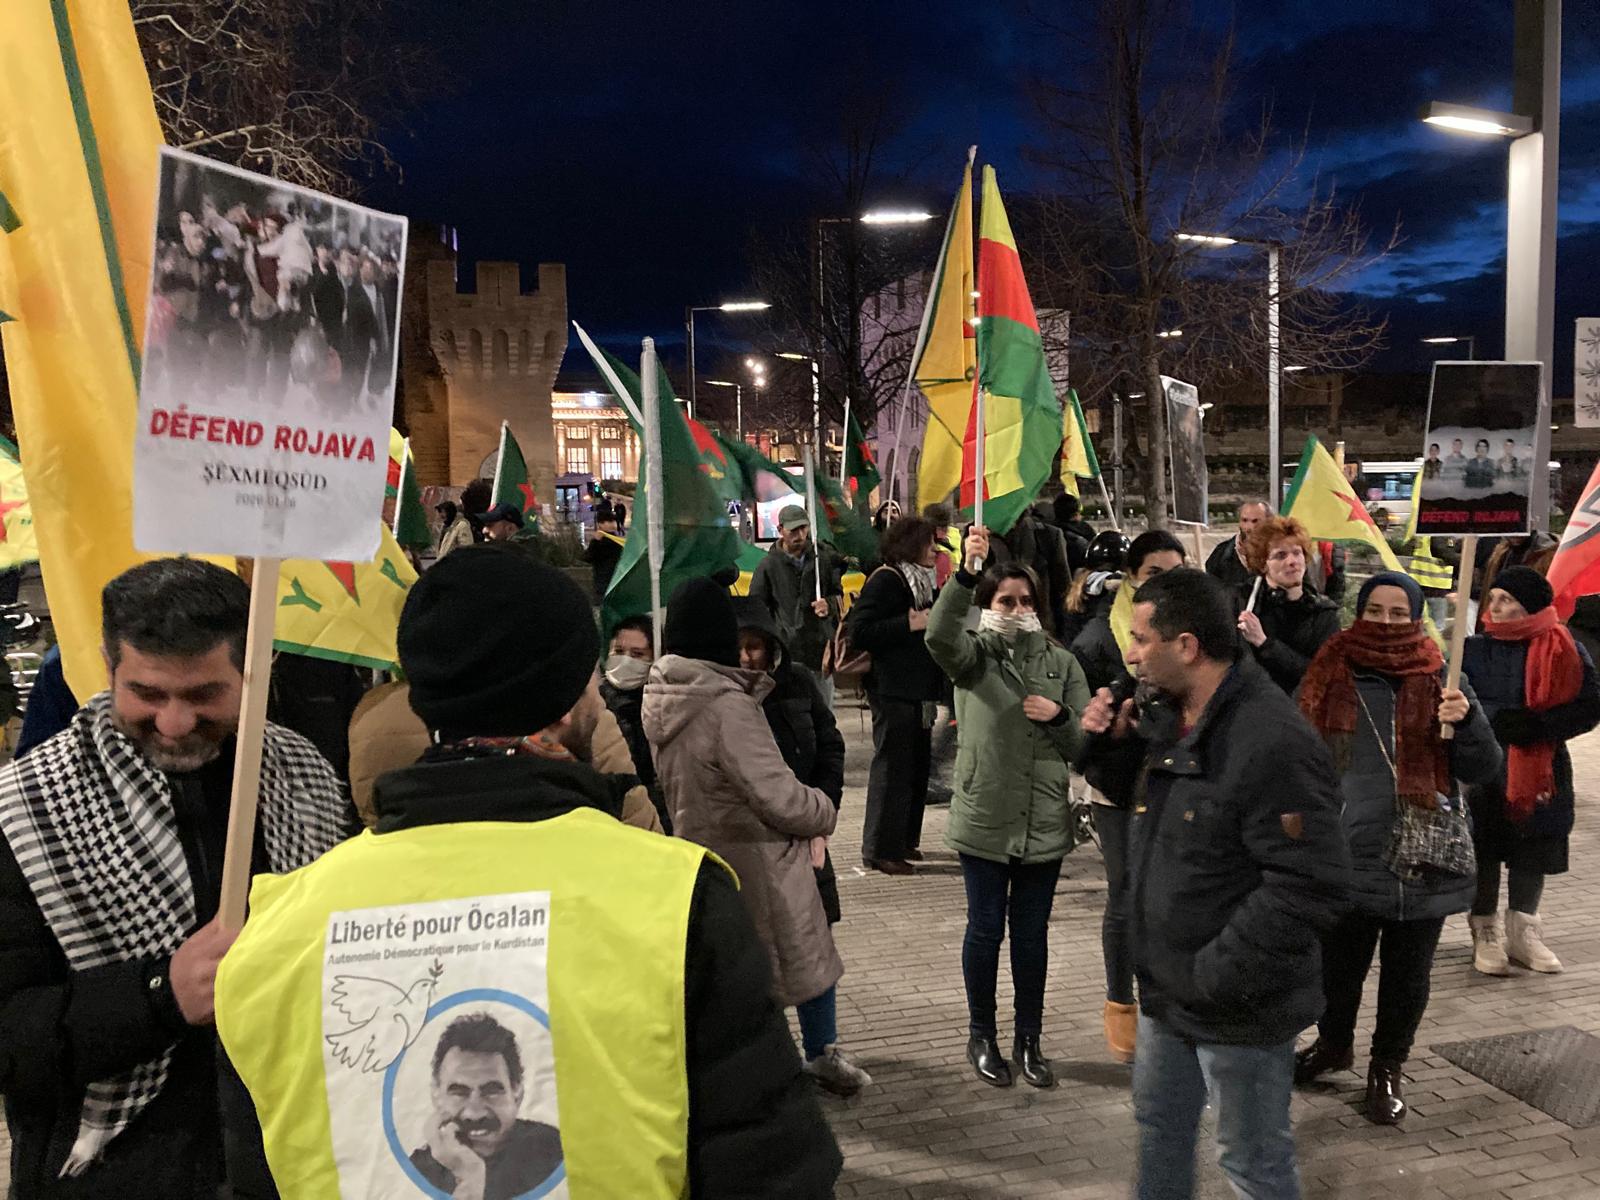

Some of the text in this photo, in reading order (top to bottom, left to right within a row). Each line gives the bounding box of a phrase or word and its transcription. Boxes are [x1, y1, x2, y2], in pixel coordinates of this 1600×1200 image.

[274, 425, 376, 462] ROJAVA
[331, 903, 546, 944] Liberté pour Öcalan
[328, 952, 381, 964] Autonomie
[383, 945, 455, 961] Démocratique
[456, 943, 481, 955] pour
[494, 937, 546, 950] Kurdistan
